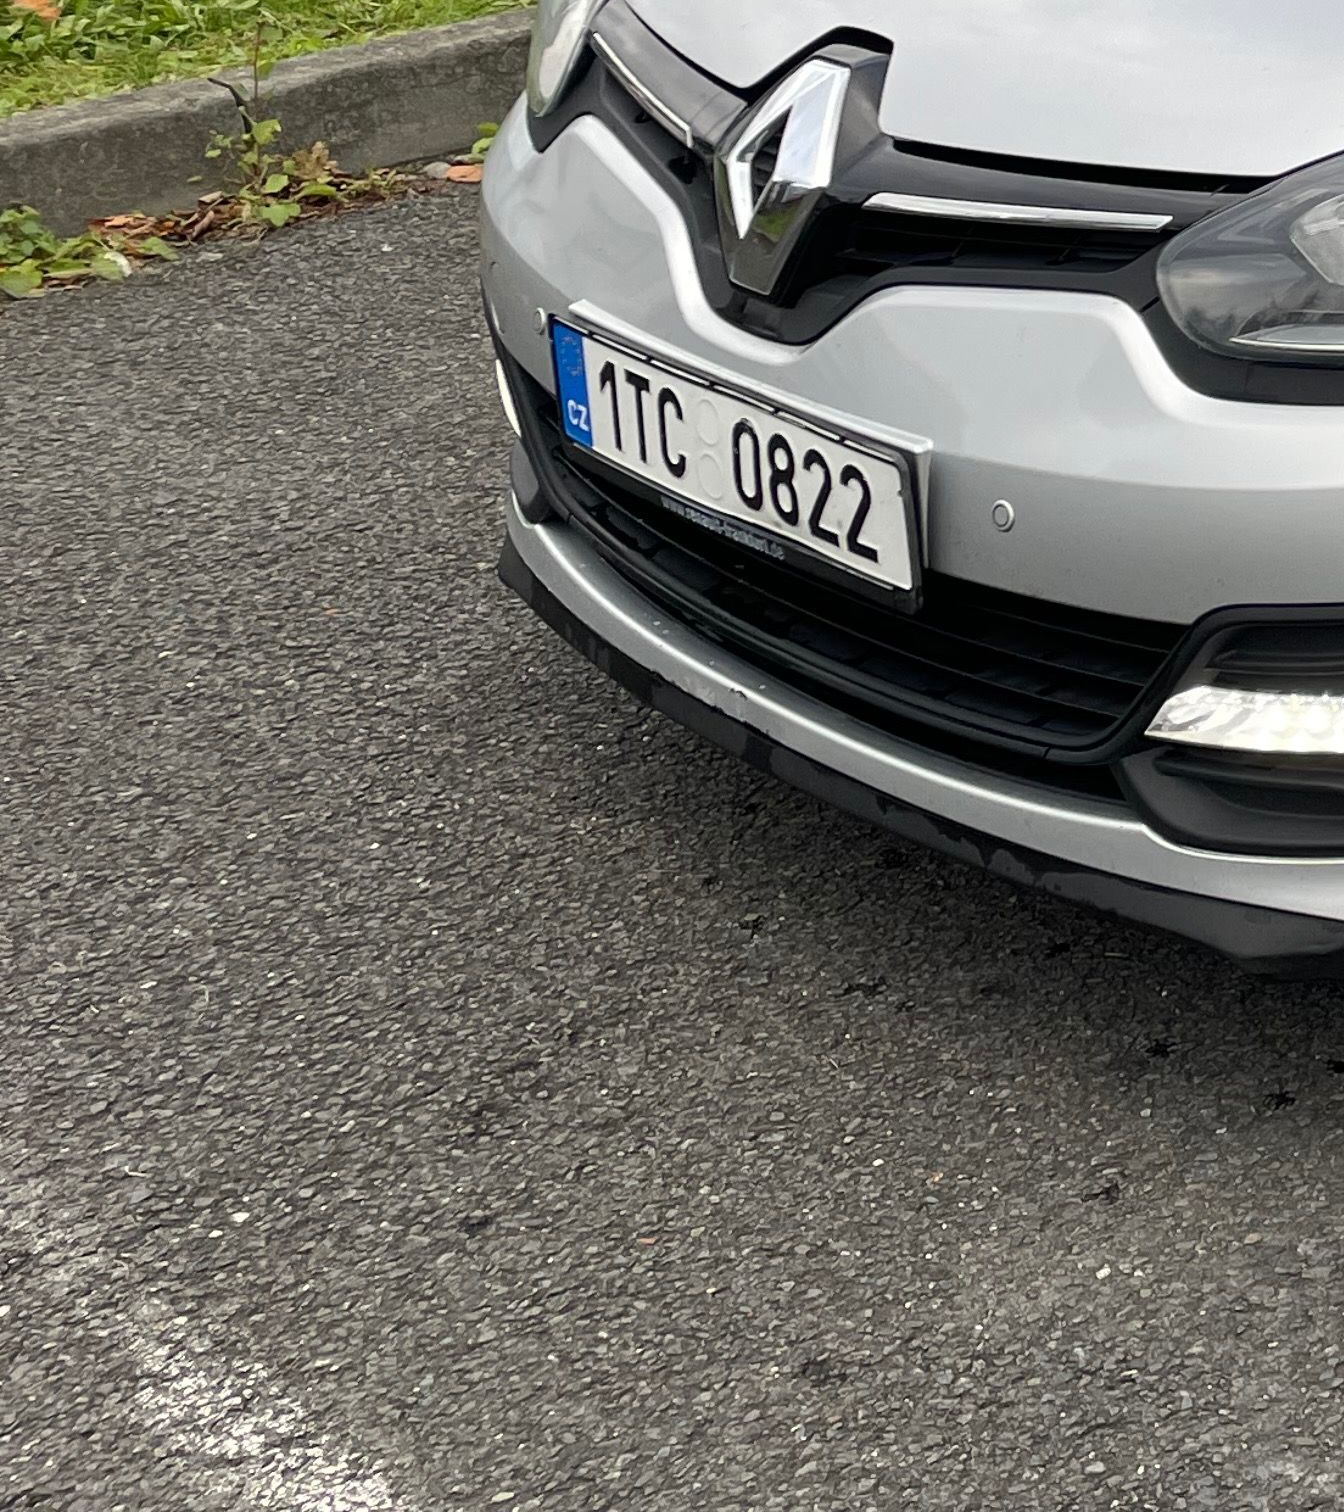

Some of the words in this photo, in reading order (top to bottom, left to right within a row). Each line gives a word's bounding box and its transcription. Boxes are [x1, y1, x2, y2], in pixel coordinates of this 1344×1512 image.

[567, 399, 590, 432] CZ
[599, 360, 687, 479] 1TC
[731, 417, 879, 564] 0822
